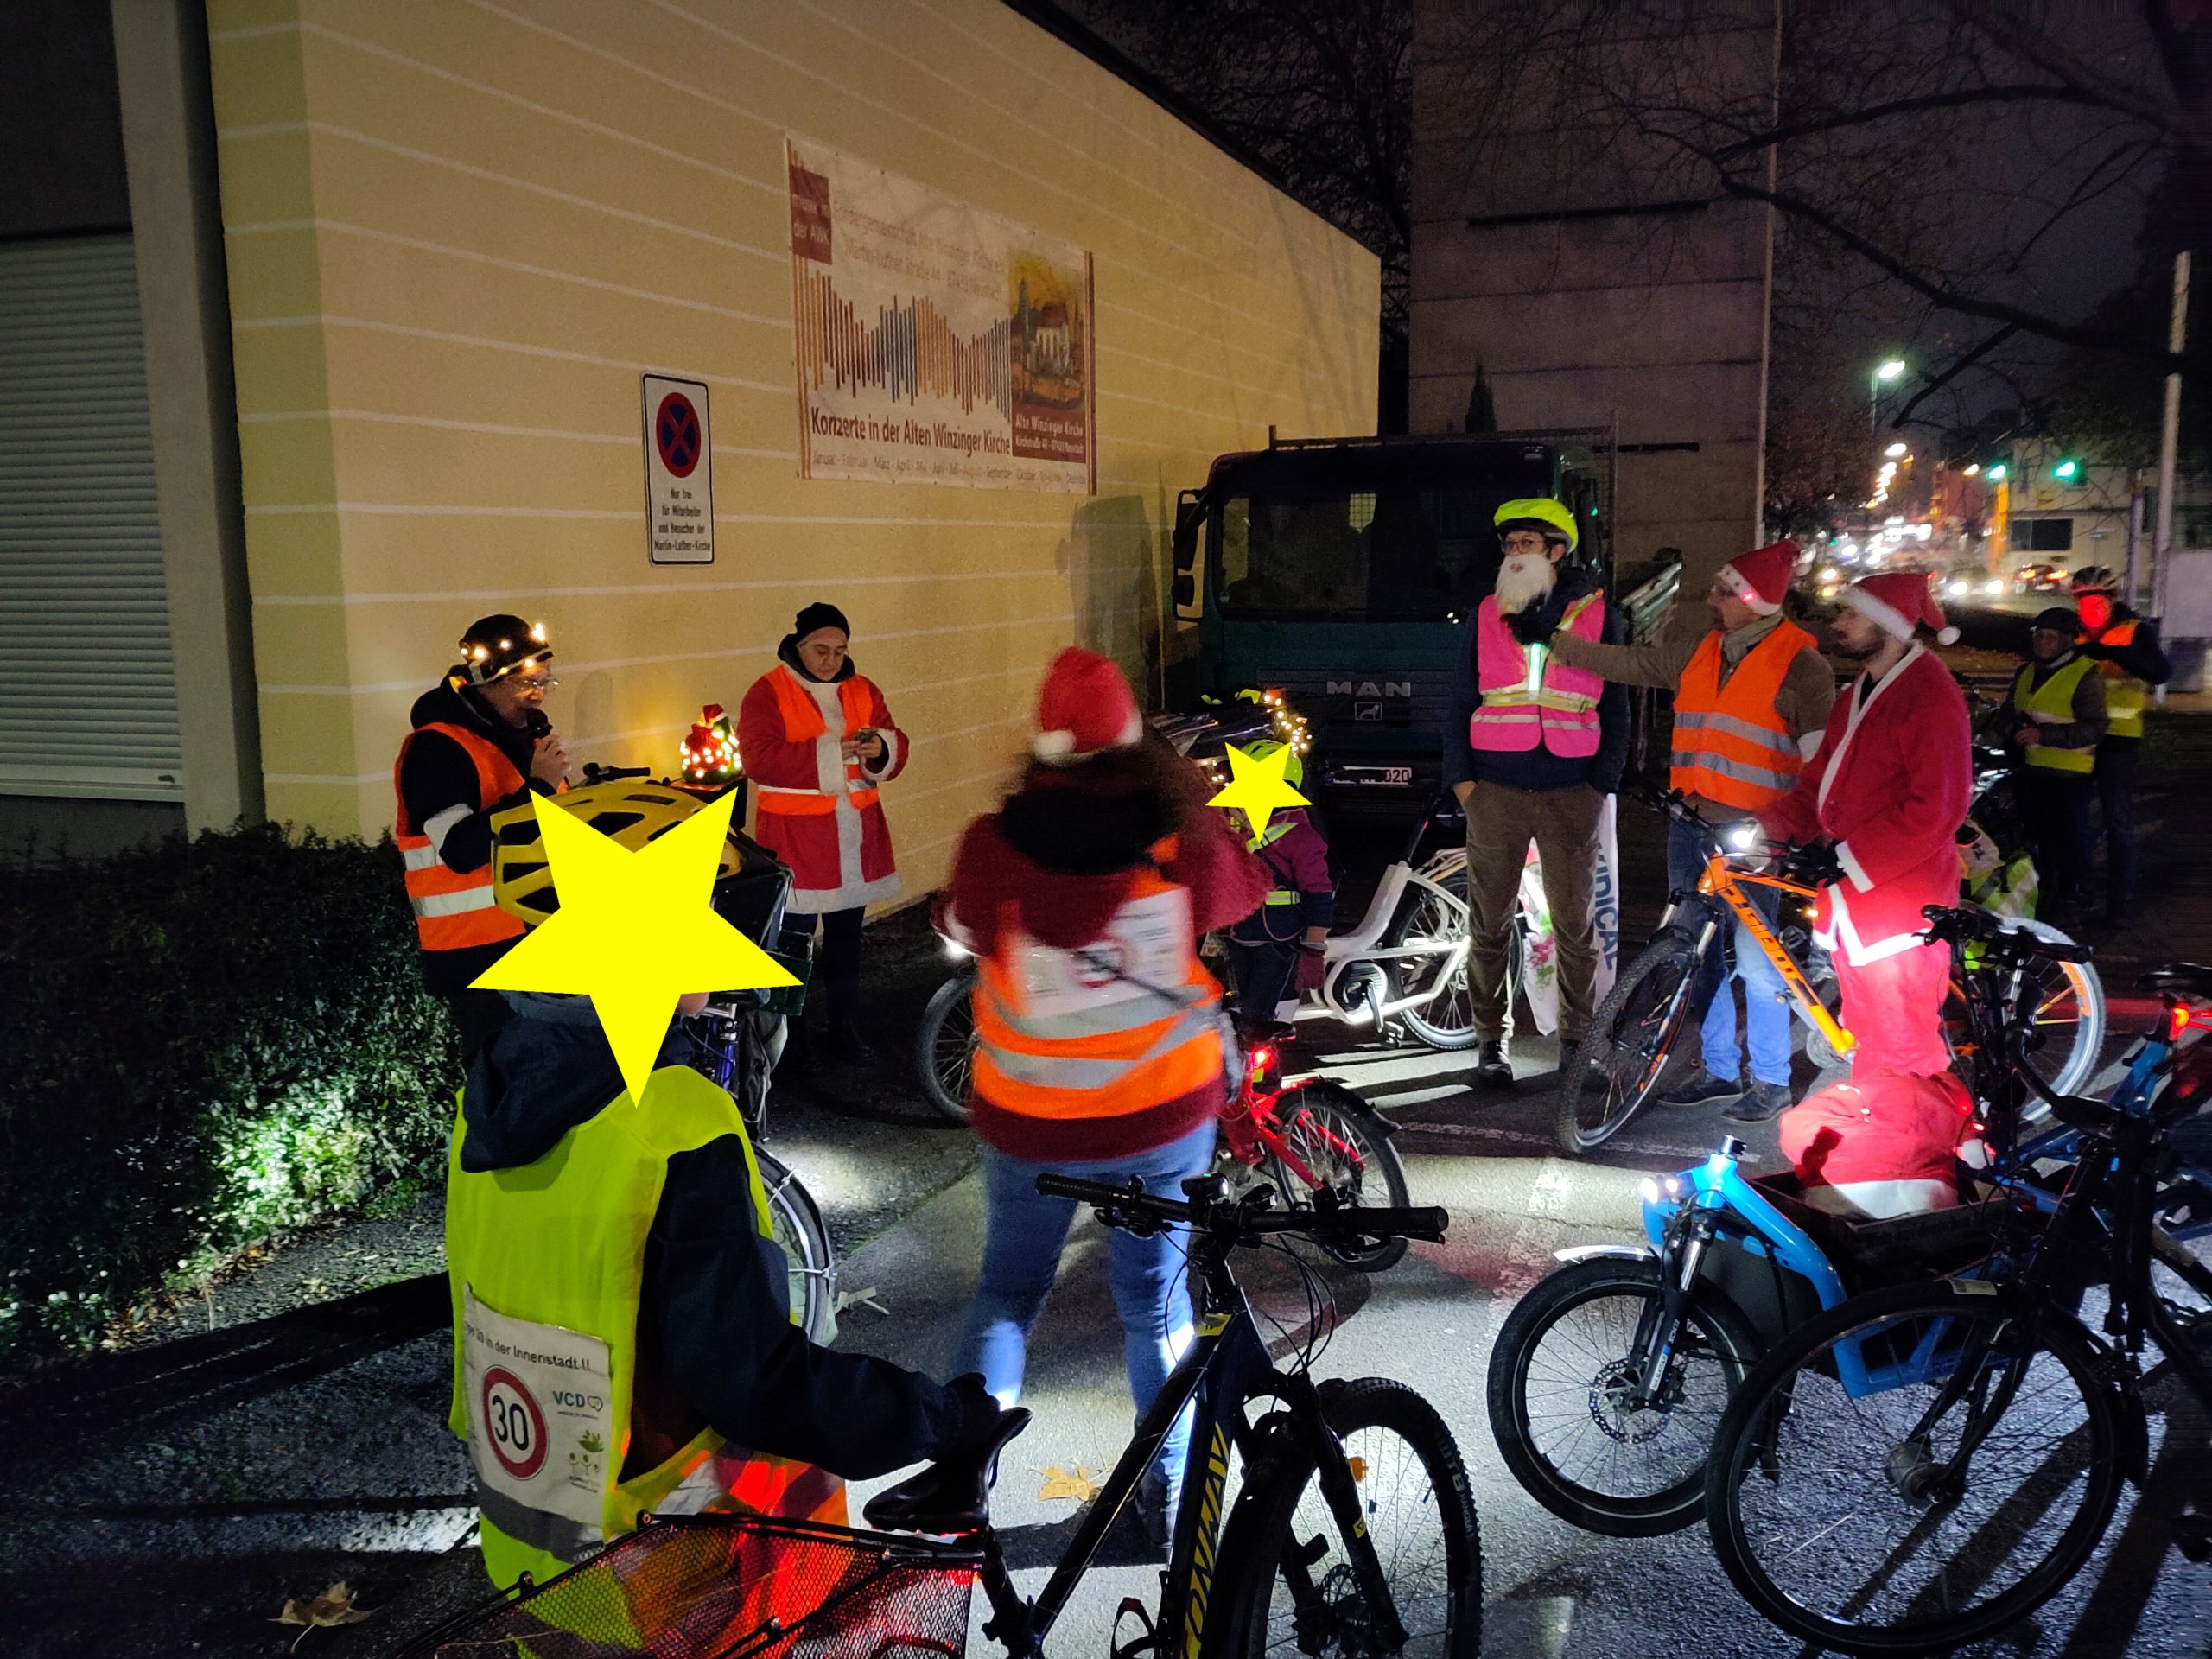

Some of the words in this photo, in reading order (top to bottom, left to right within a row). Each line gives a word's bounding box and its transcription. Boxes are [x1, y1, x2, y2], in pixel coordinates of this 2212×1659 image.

[811, 406, 866, 440] Konzerte
[868, 413, 880, 441] in
[882, 415, 900, 443] der
[904, 418, 931, 447] Alten
[933, 423, 981, 458] Winzinger
[983, 429, 1010, 455] Kirche
[1326, 681, 1411, 697] MAN
[495, 1340, 512, 1356] der
[512, 1344, 579, 1370] Innenstadt
[552, 1389, 586, 1409] VCD
[492, 1394, 530, 1452] 30
